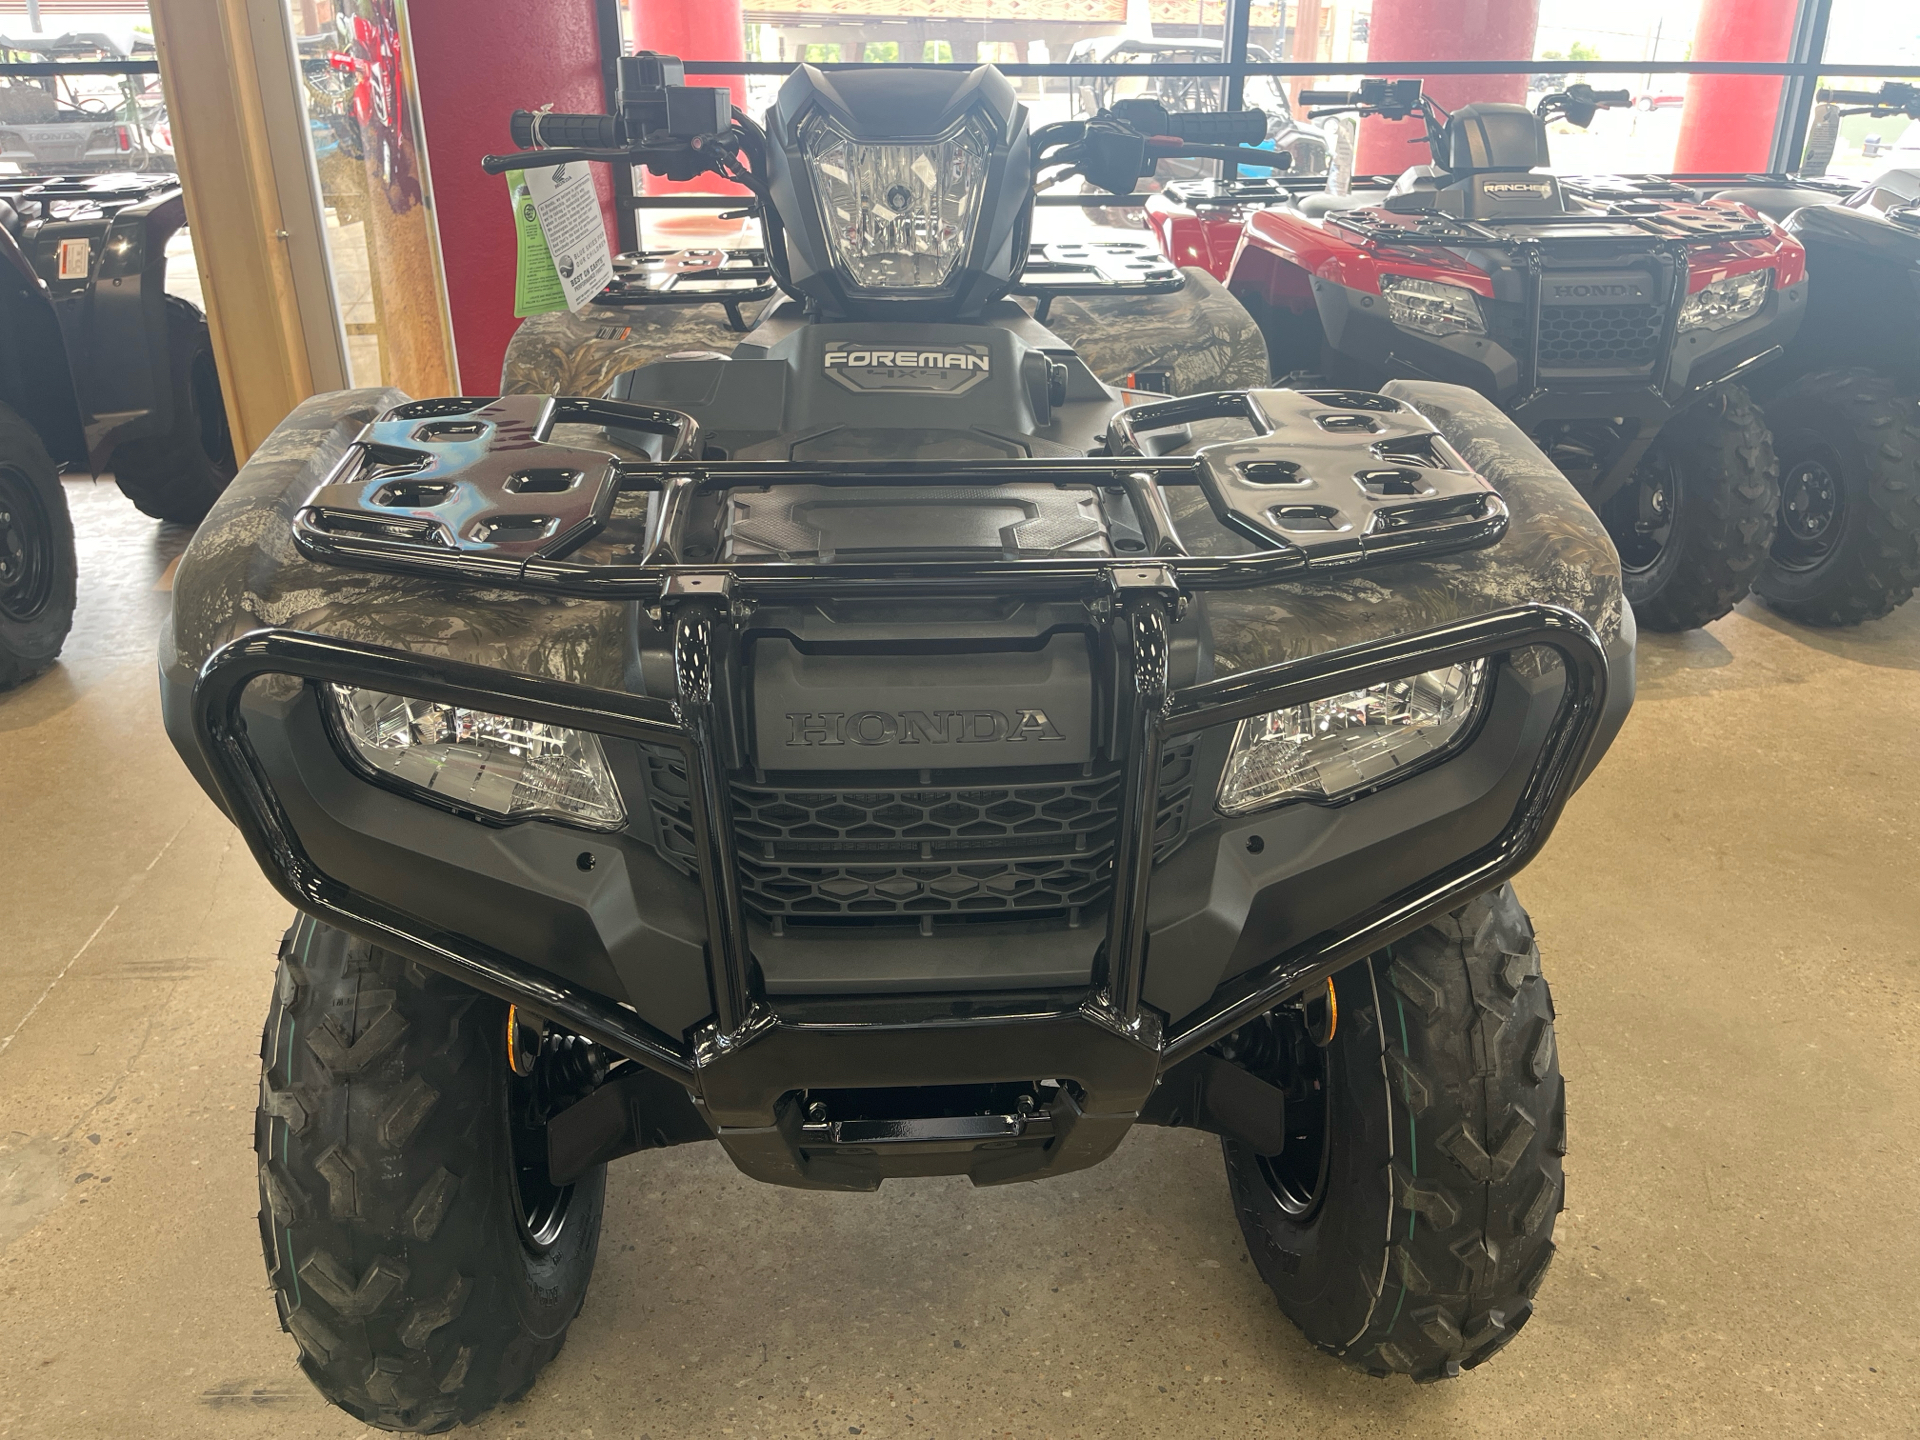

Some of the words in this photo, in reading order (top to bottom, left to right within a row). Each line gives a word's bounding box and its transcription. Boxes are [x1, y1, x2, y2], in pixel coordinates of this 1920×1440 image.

[28, 132, 86, 141] HONDA
[555, 176, 572, 189] HONDA
[1484, 183, 1551, 193] RANCHER
[574, 247, 585, 260] BLUE
[586, 237, 597, 252] SKIES
[576, 257, 586, 267] OUR
[587, 240, 606, 259] CHILDREN
[570, 273, 583, 287] BEST
[584, 267, 590, 277] ON
[1553, 284, 1645, 298] HONDA
[824, 351, 989, 371] FOREMAN
[785, 708, 1067, 747] HONDA
